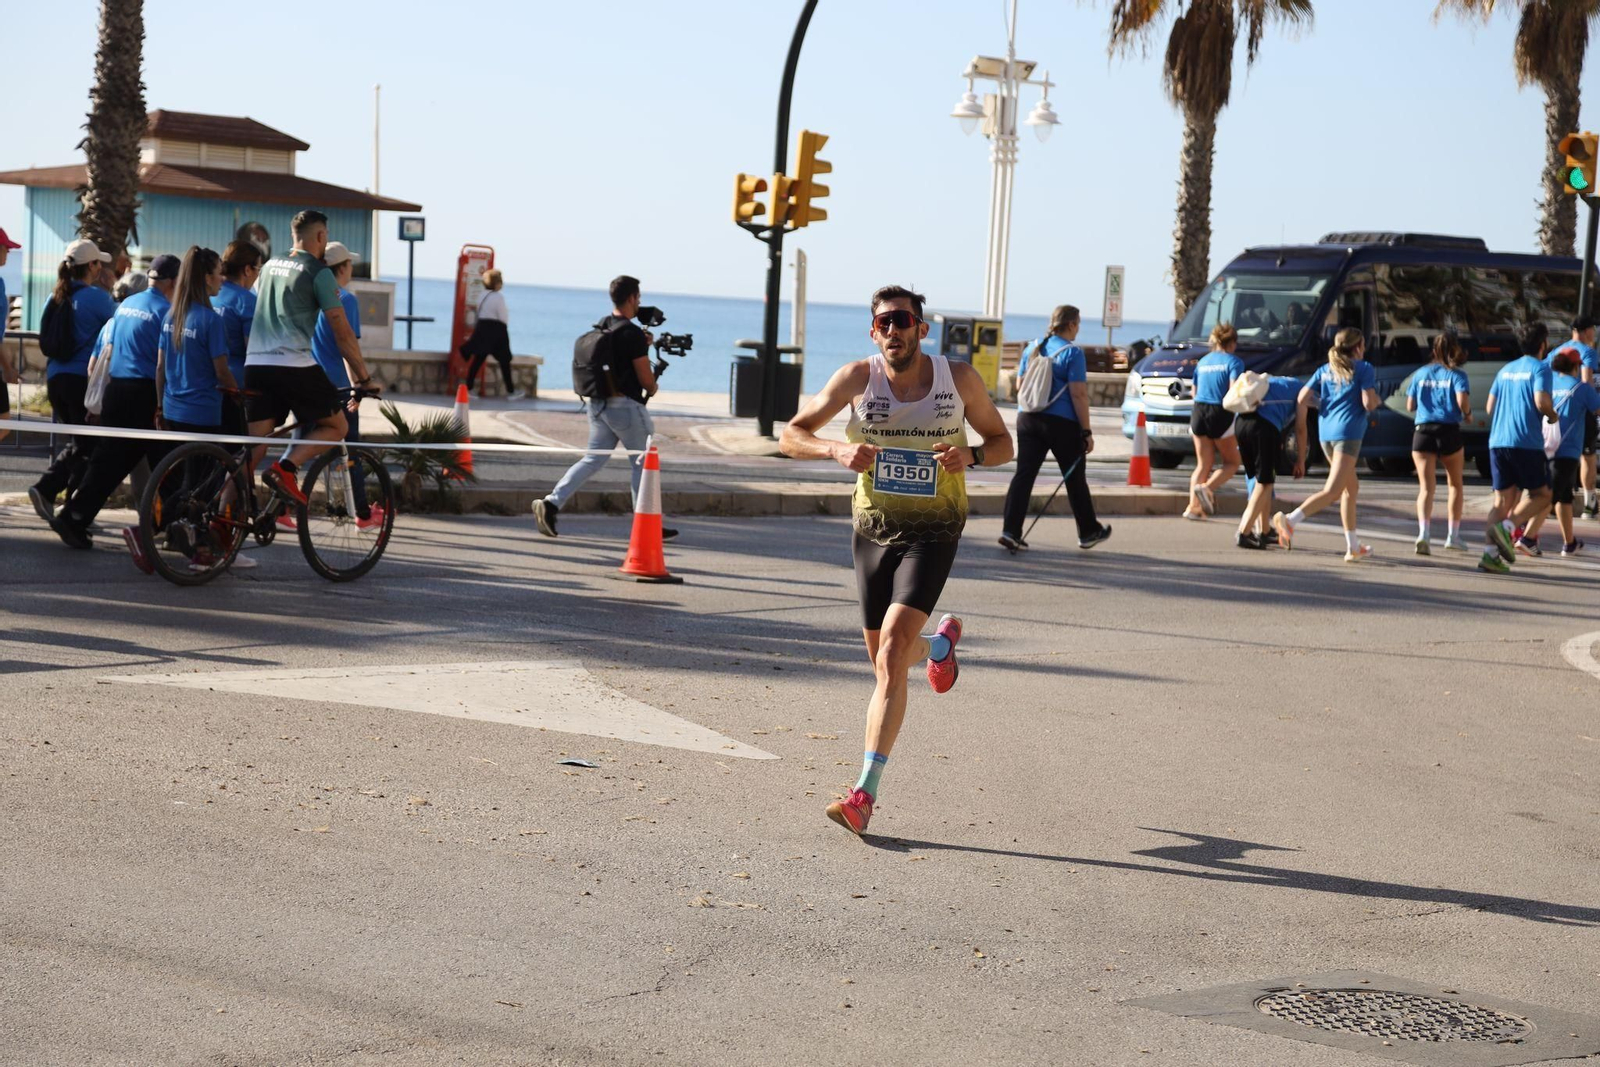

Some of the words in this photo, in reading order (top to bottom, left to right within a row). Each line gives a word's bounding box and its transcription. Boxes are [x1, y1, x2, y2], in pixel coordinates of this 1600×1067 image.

[269, 267, 290, 277] CIVIL
[880, 427, 925, 437] TRIATLÓN
[927, 427, 959, 438] MÁLAGA
[883, 464, 930, 480] 1950
